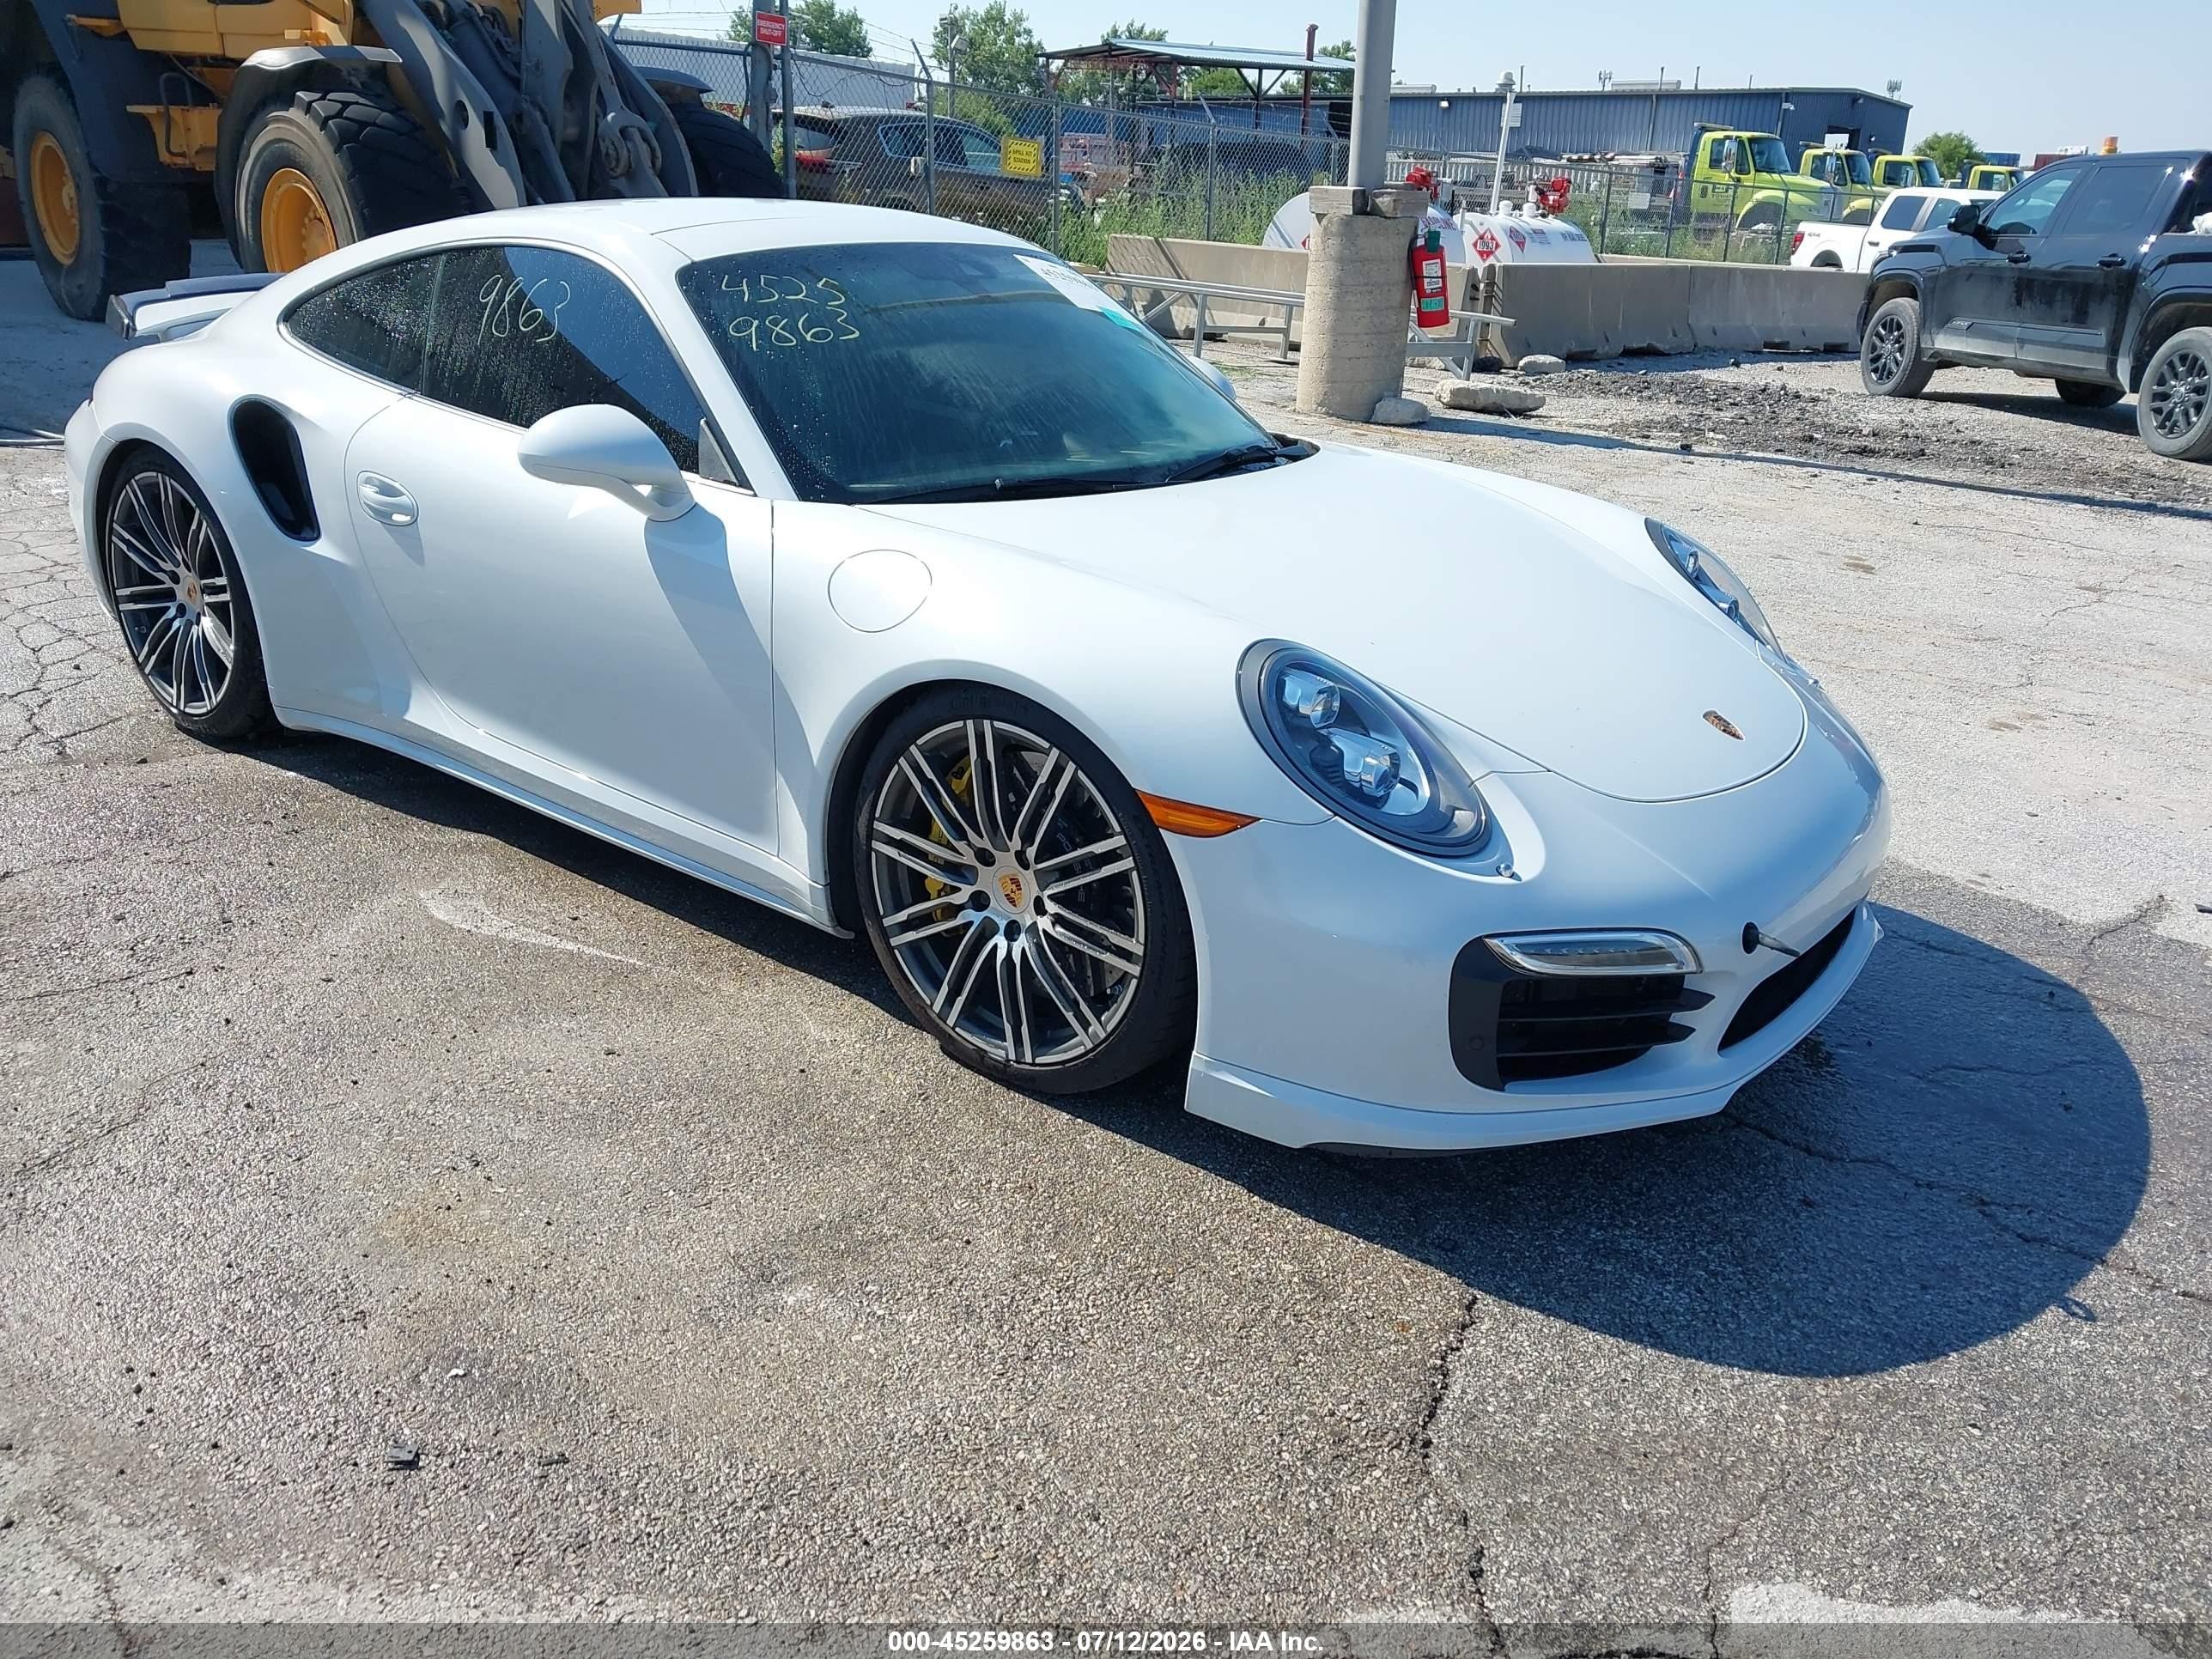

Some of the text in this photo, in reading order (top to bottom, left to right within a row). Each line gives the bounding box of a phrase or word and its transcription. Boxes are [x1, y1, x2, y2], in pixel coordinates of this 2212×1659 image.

[1478, 240, 1494, 250] 1993
[721, 274, 846, 306] 4525
[477, 275, 571, 345] 9863
[728, 306, 860, 352] 9863
